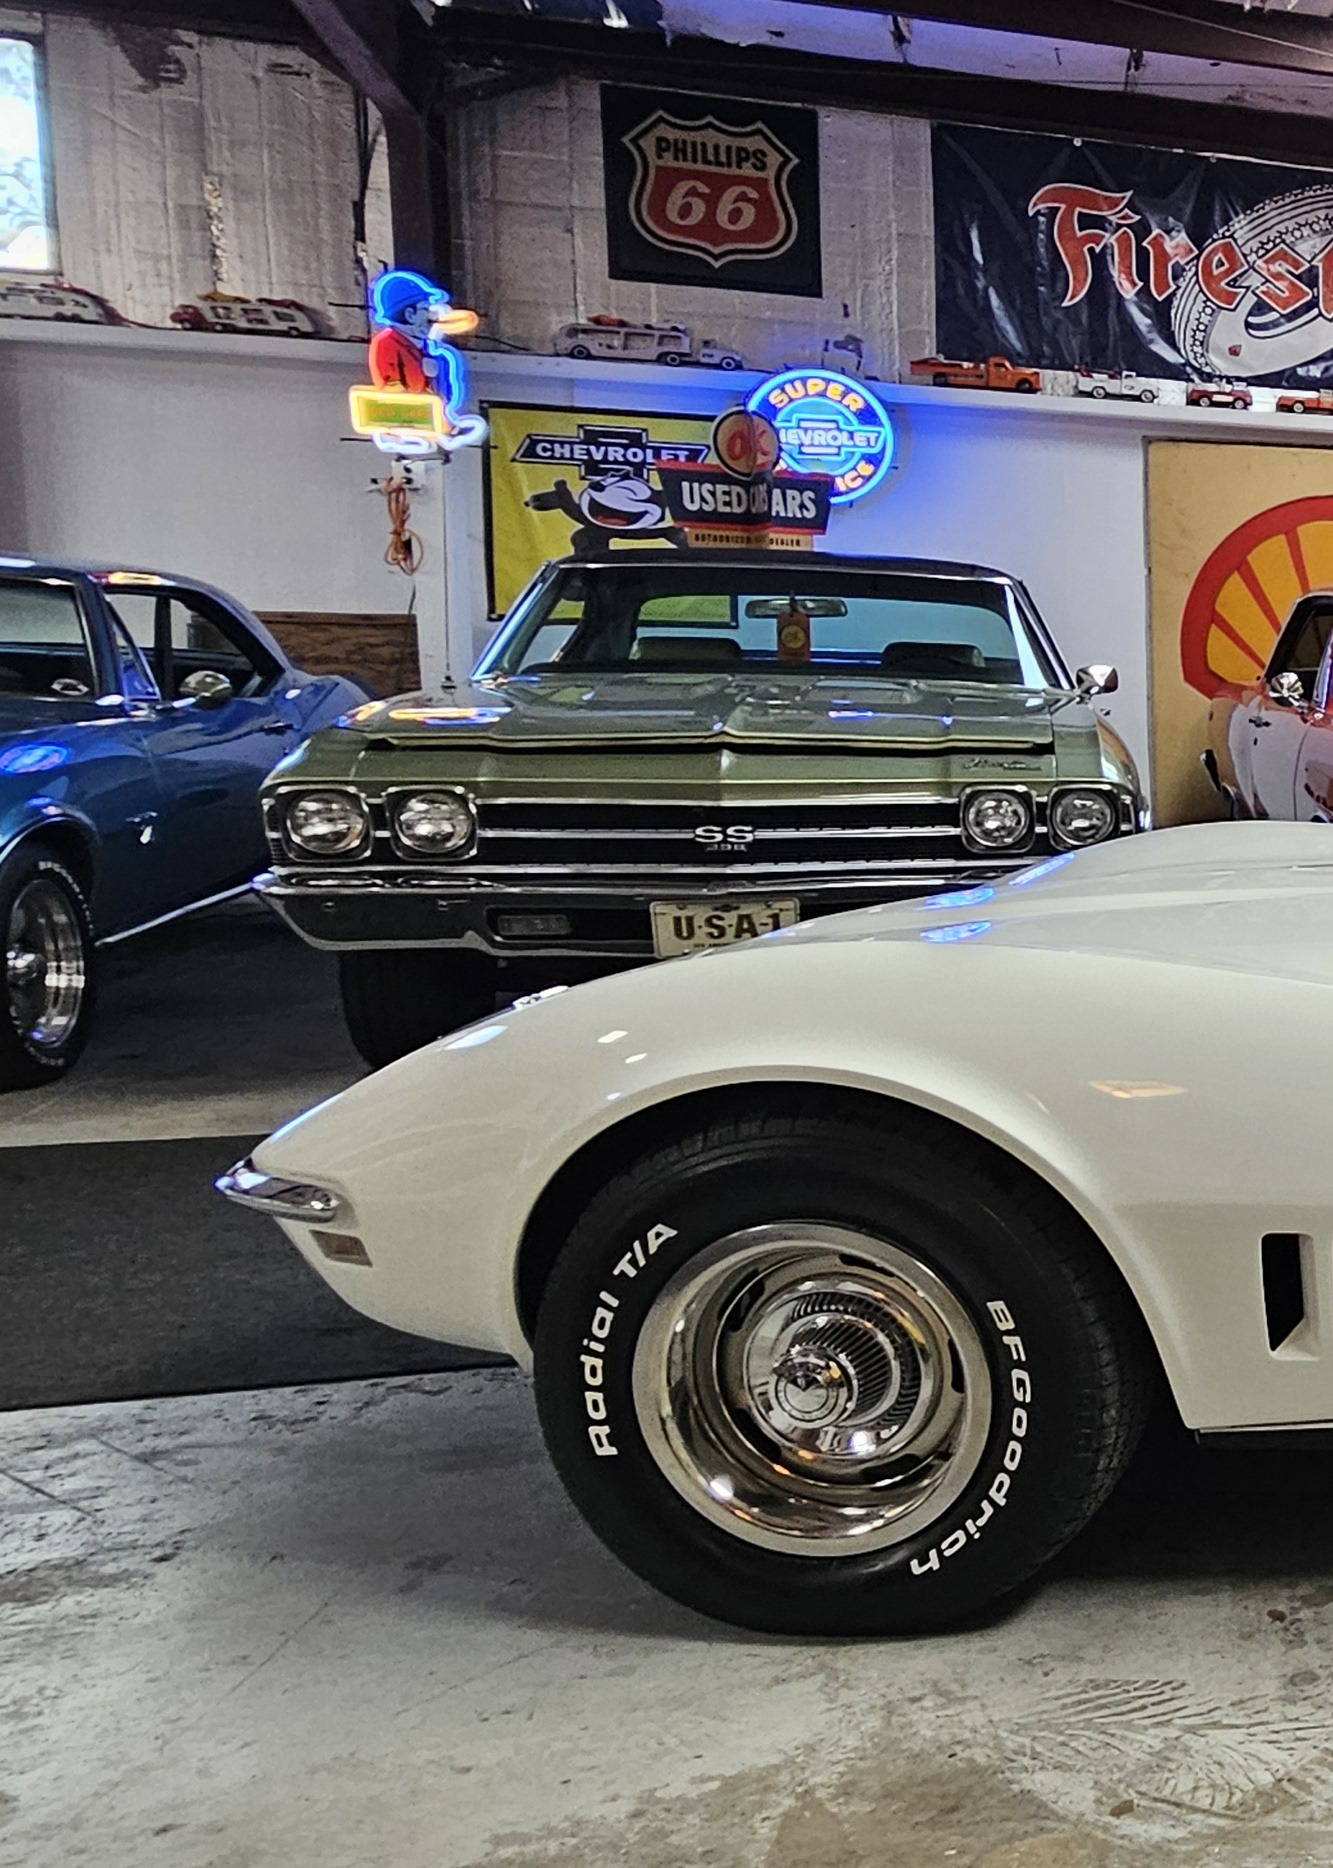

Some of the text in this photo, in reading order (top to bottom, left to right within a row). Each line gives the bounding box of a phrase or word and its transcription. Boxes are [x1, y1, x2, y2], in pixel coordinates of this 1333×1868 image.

[655, 136, 768, 172] PHILLIPS
[666, 180, 760, 231] 66
[768, 378, 866, 413] SUPER
[536, 442, 690, 463] CHEVROLET
[779, 427, 880, 448] EVROLET
[681, 481, 748, 515] USED
[694, 825, 755, 843] SS
[580, 1223, 679, 1456] Radial T/A
[910, 1300, 1032, 1576] BFGoodrich
